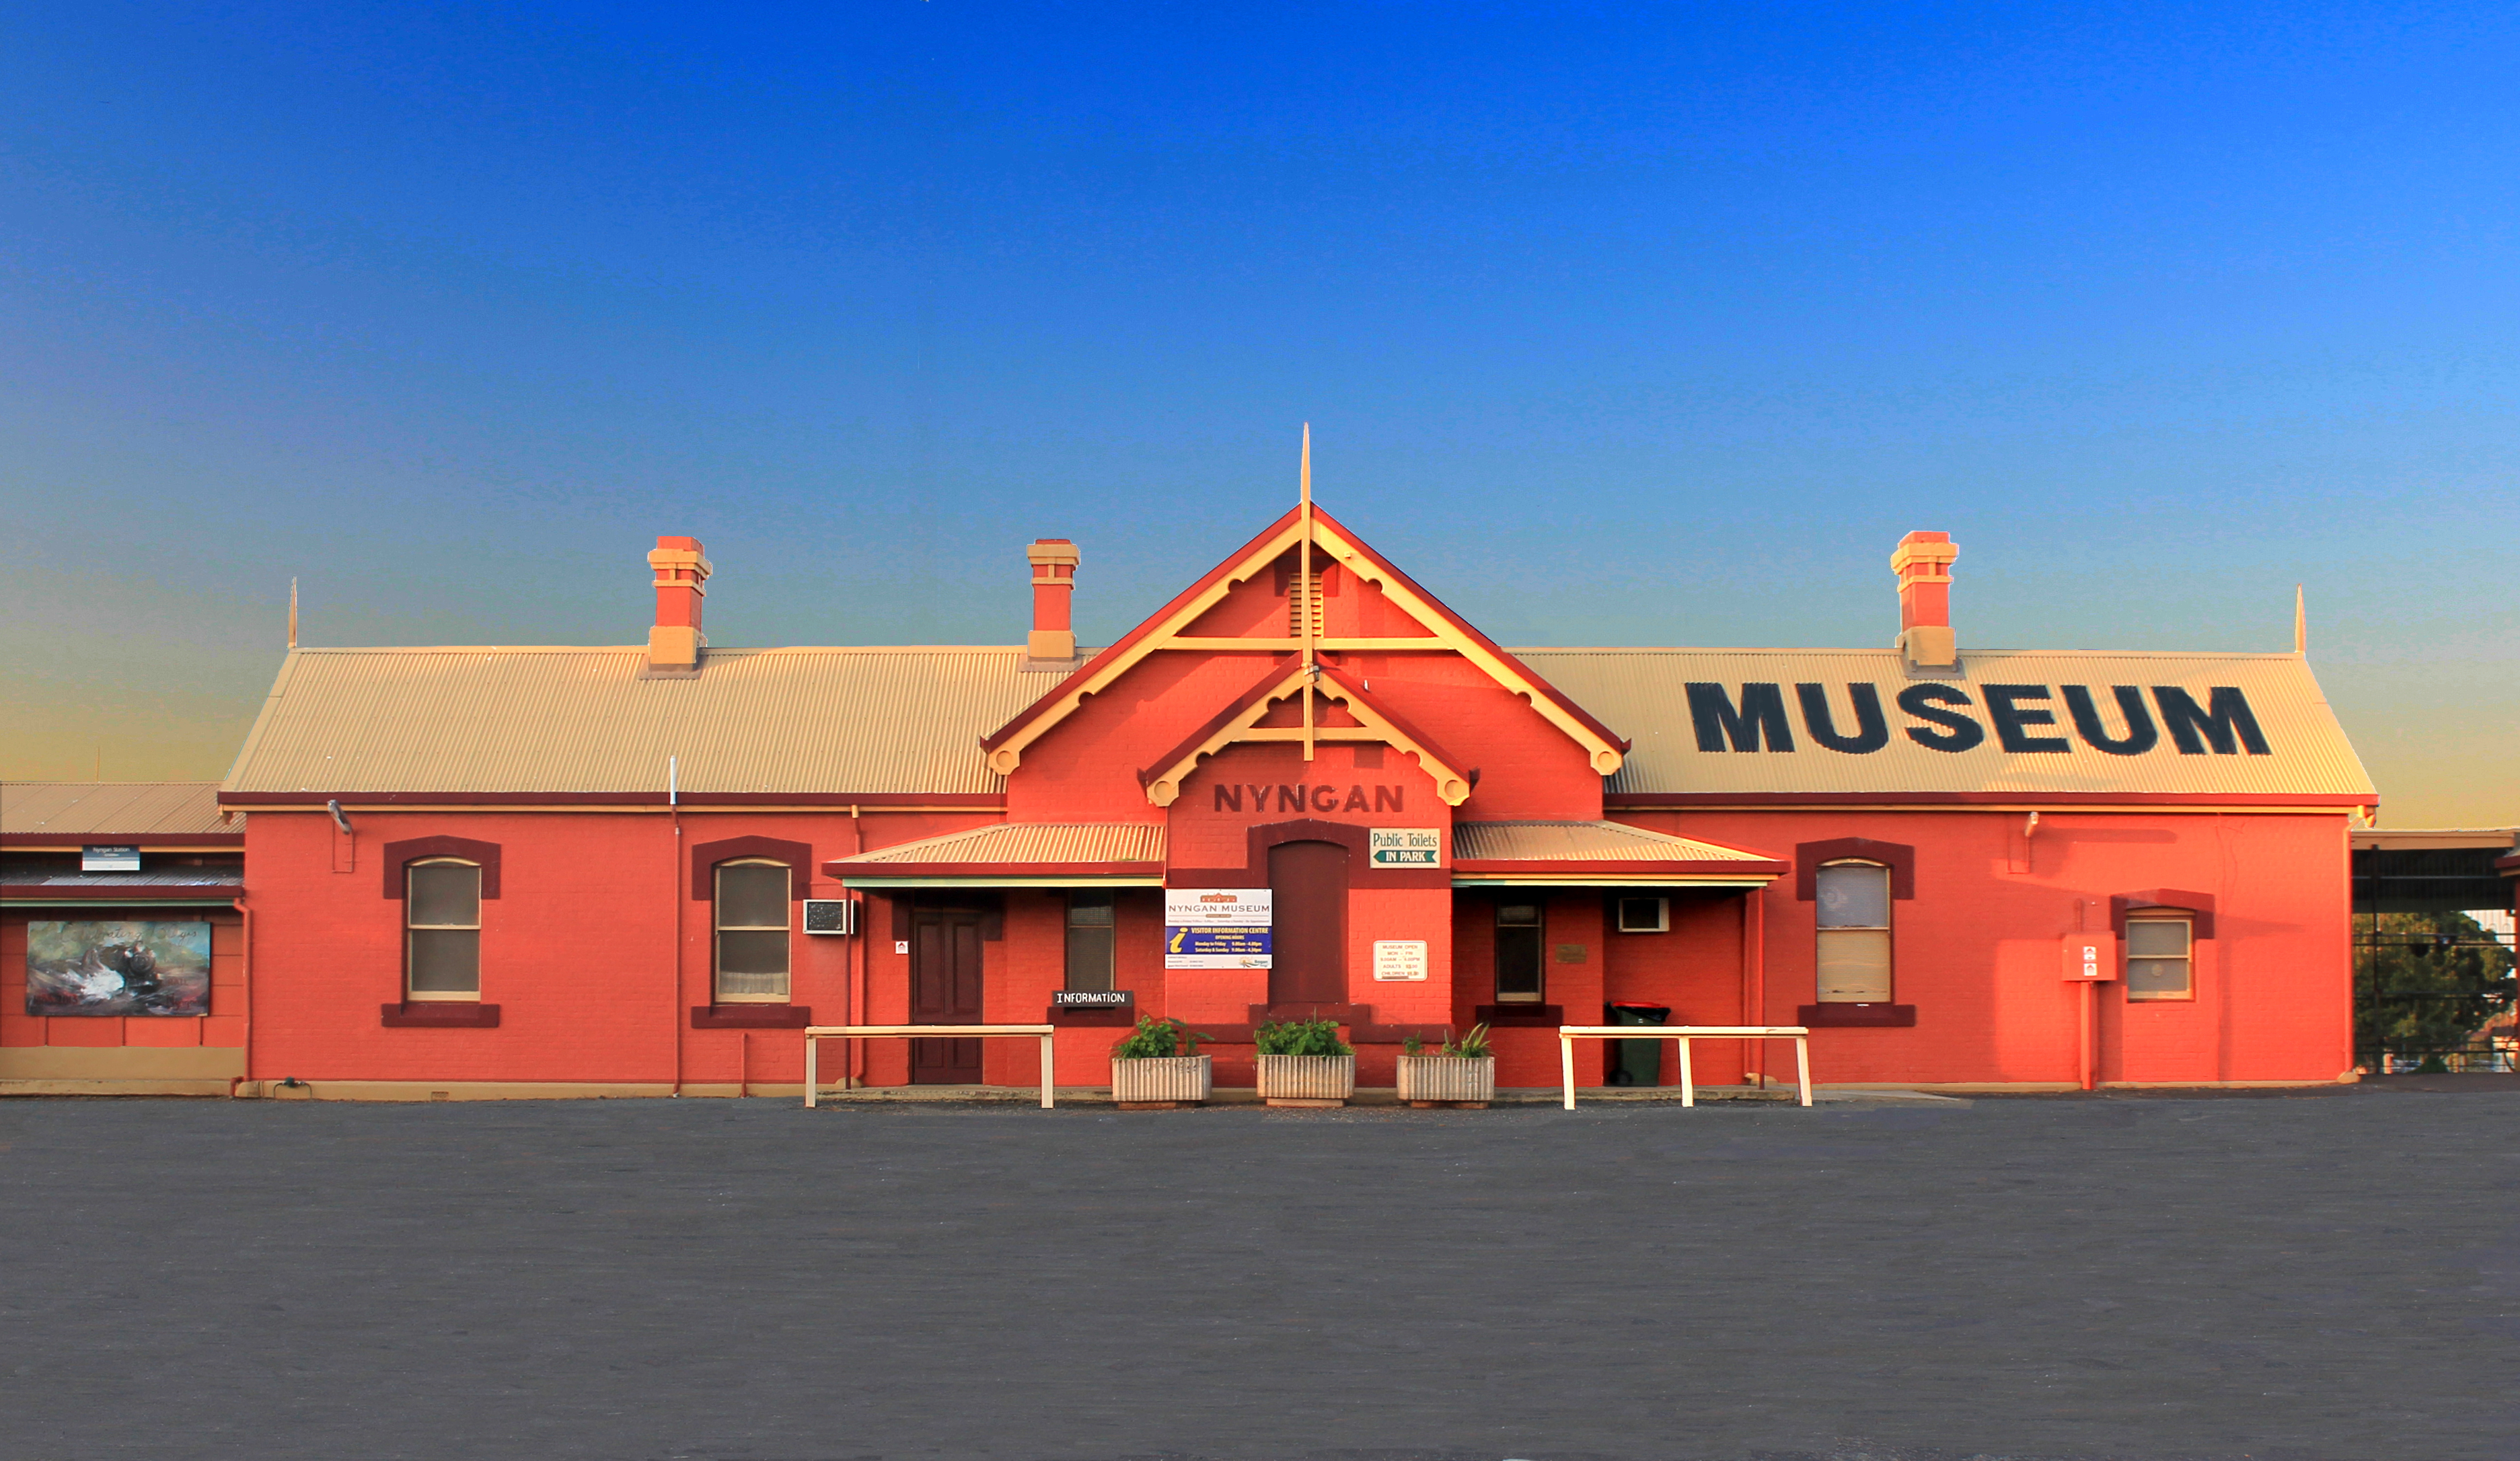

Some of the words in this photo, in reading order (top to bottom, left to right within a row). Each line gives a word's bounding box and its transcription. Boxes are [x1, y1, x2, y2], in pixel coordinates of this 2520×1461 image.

[1684, 681, 2272, 757] MUSEUM
[1214, 784, 1404, 813] NYNGAN
[1373, 833, 1403, 847] Public
[1407, 833, 1438, 847] Toilets
[1386, 851, 1397, 862] IN
[1400, 851, 1426, 862] PARK
